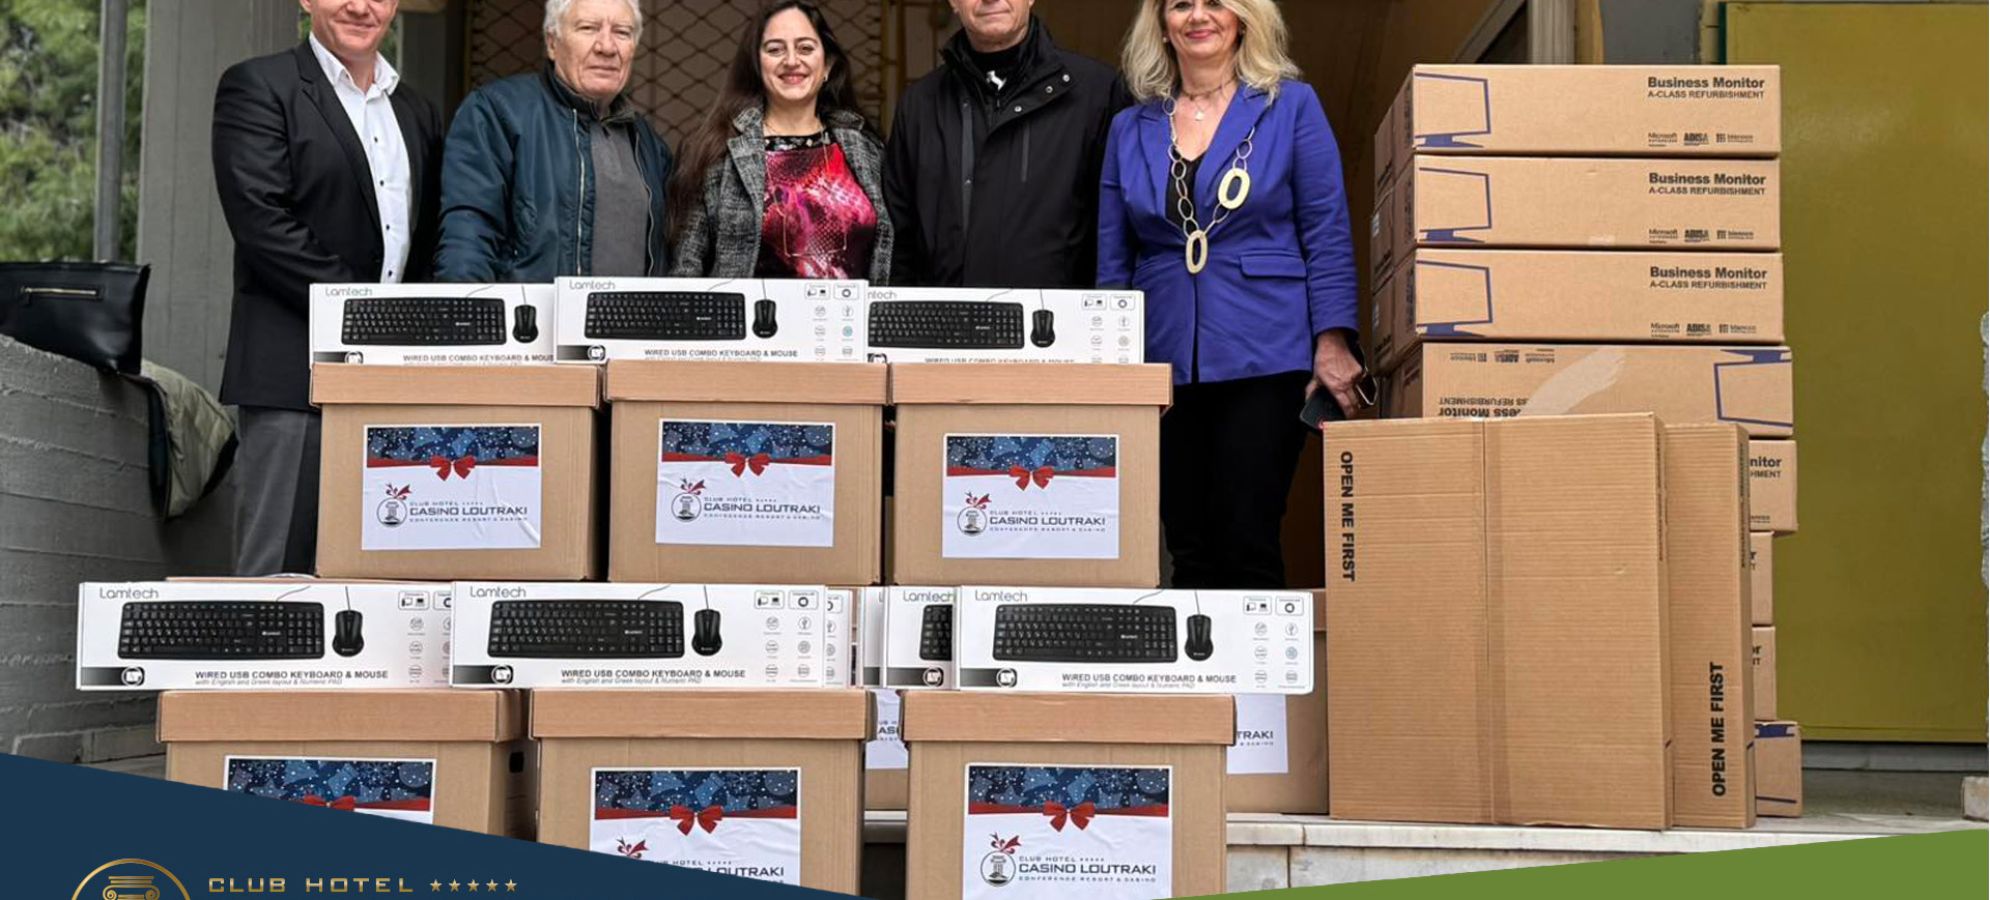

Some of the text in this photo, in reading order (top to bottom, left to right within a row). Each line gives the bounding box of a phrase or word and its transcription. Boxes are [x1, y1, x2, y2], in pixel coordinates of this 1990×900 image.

[1648, 77, 1765, 88] Business Monitor
[1648, 90, 1765, 98] A-CLASS REFURBISHMENT
[1649, 173, 1766, 185] Business Monitor
[1690, 187, 1766, 195] REFURBISHMENT
[1650, 266, 1767, 279] Business Monitor
[569, 280, 616, 290] Lamtech
[1691, 281, 1767, 289] REFURBISHMENT
[325, 287, 372, 297] Lamtech
[1440, 397, 1514, 406] REFURBISHMENT
[1439, 408, 1490, 417] Monitor
[410, 507, 528, 516] CASINO LOUTRAKI
[704, 503, 820, 514] CASINO LOUTRAKI
[990, 517, 1105, 525] CASINO LOUTRAKI
[1340, 451, 1355, 582] OPEN ME FIRST
[100, 587, 159, 599] Lamtech
[469, 586, 526, 598] Lamtech
[903, 590, 955, 602] Lamtech
[975, 590, 1028, 602] Lamtech
[195, 671, 388, 679] WIRED USB COMBO KEYBOARD & MOUSE
[1709, 661, 1726, 797] OPEN ME FIRST
[1019, 863, 1156, 875] CASINO LOUTRAKI
